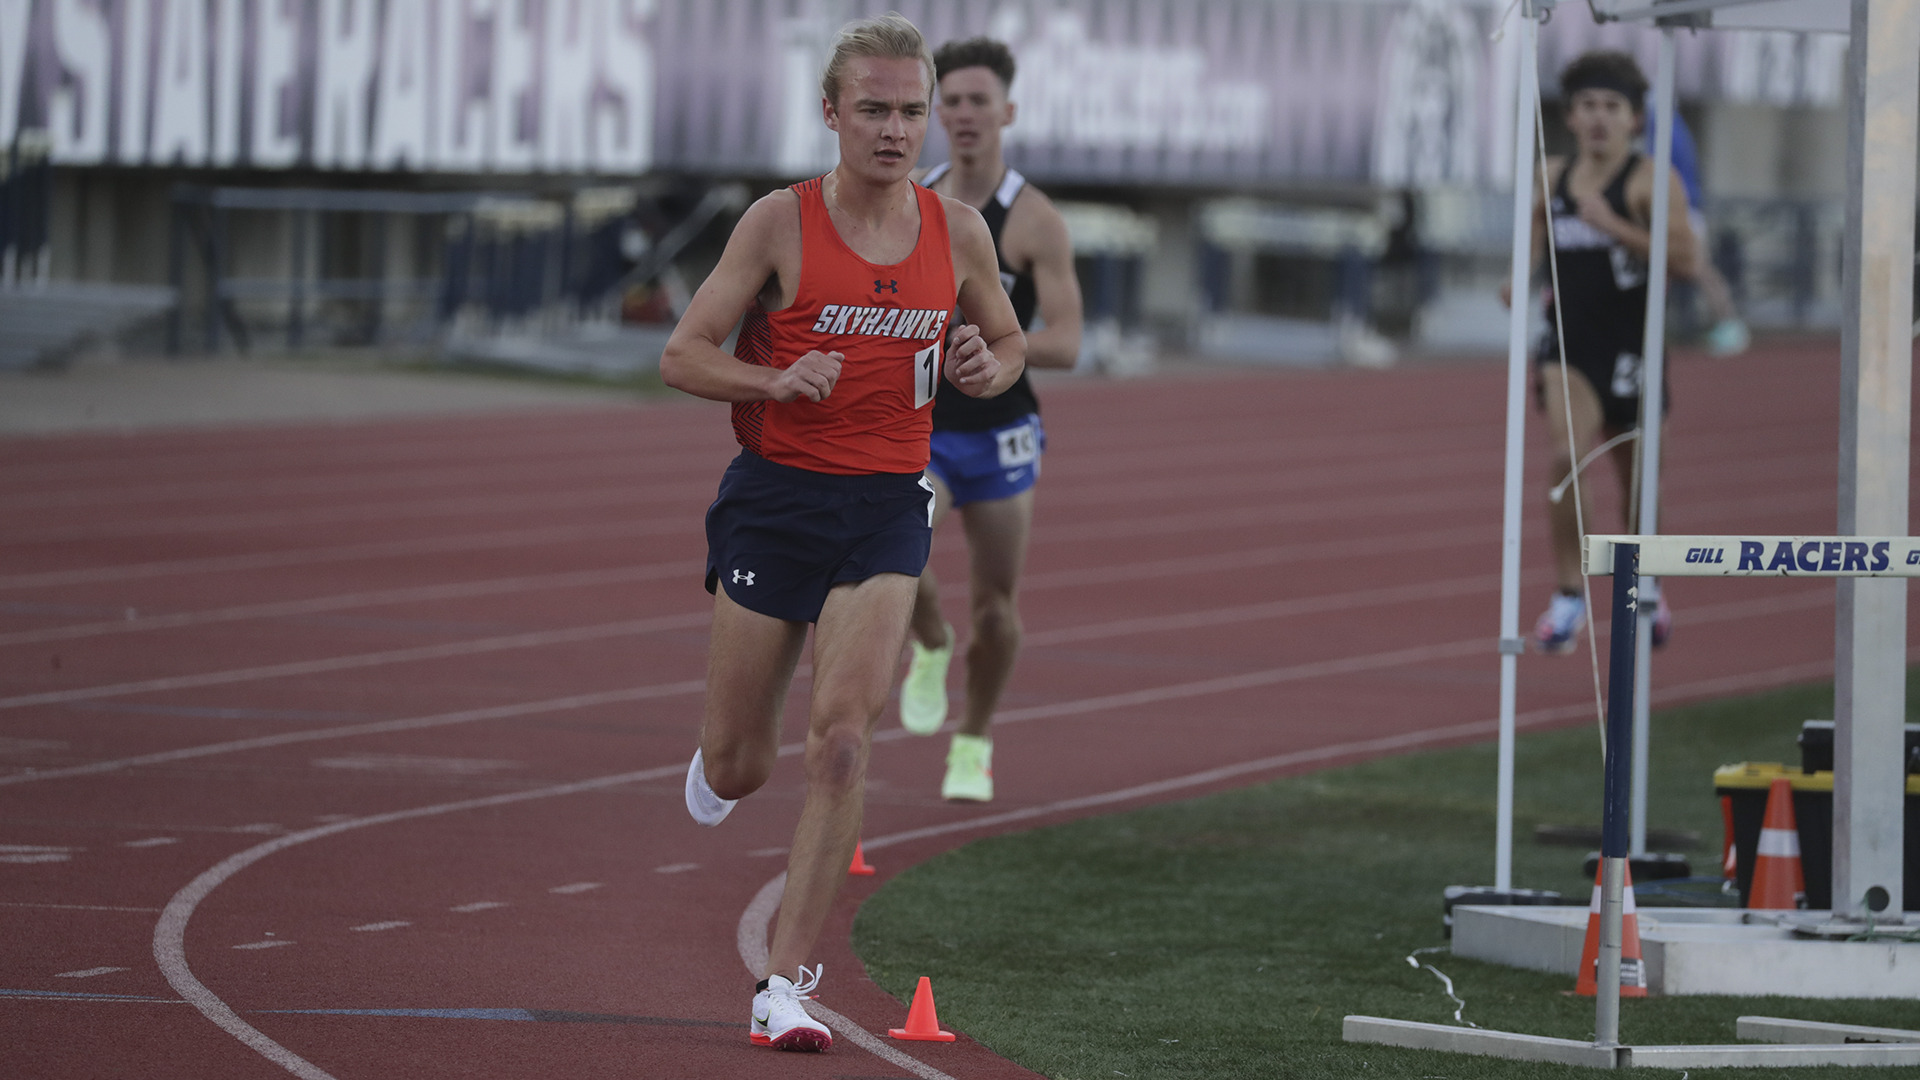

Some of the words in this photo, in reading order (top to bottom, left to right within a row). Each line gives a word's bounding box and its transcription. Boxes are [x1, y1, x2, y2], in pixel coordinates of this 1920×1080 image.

[312, 0, 652, 174] RACERS
[811, 303, 949, 340] SKYHAWKS
[922, 348, 935, 400] 1
[1685, 547, 1724, 564] GILL
[1737, 540, 1890, 572] RACERS
